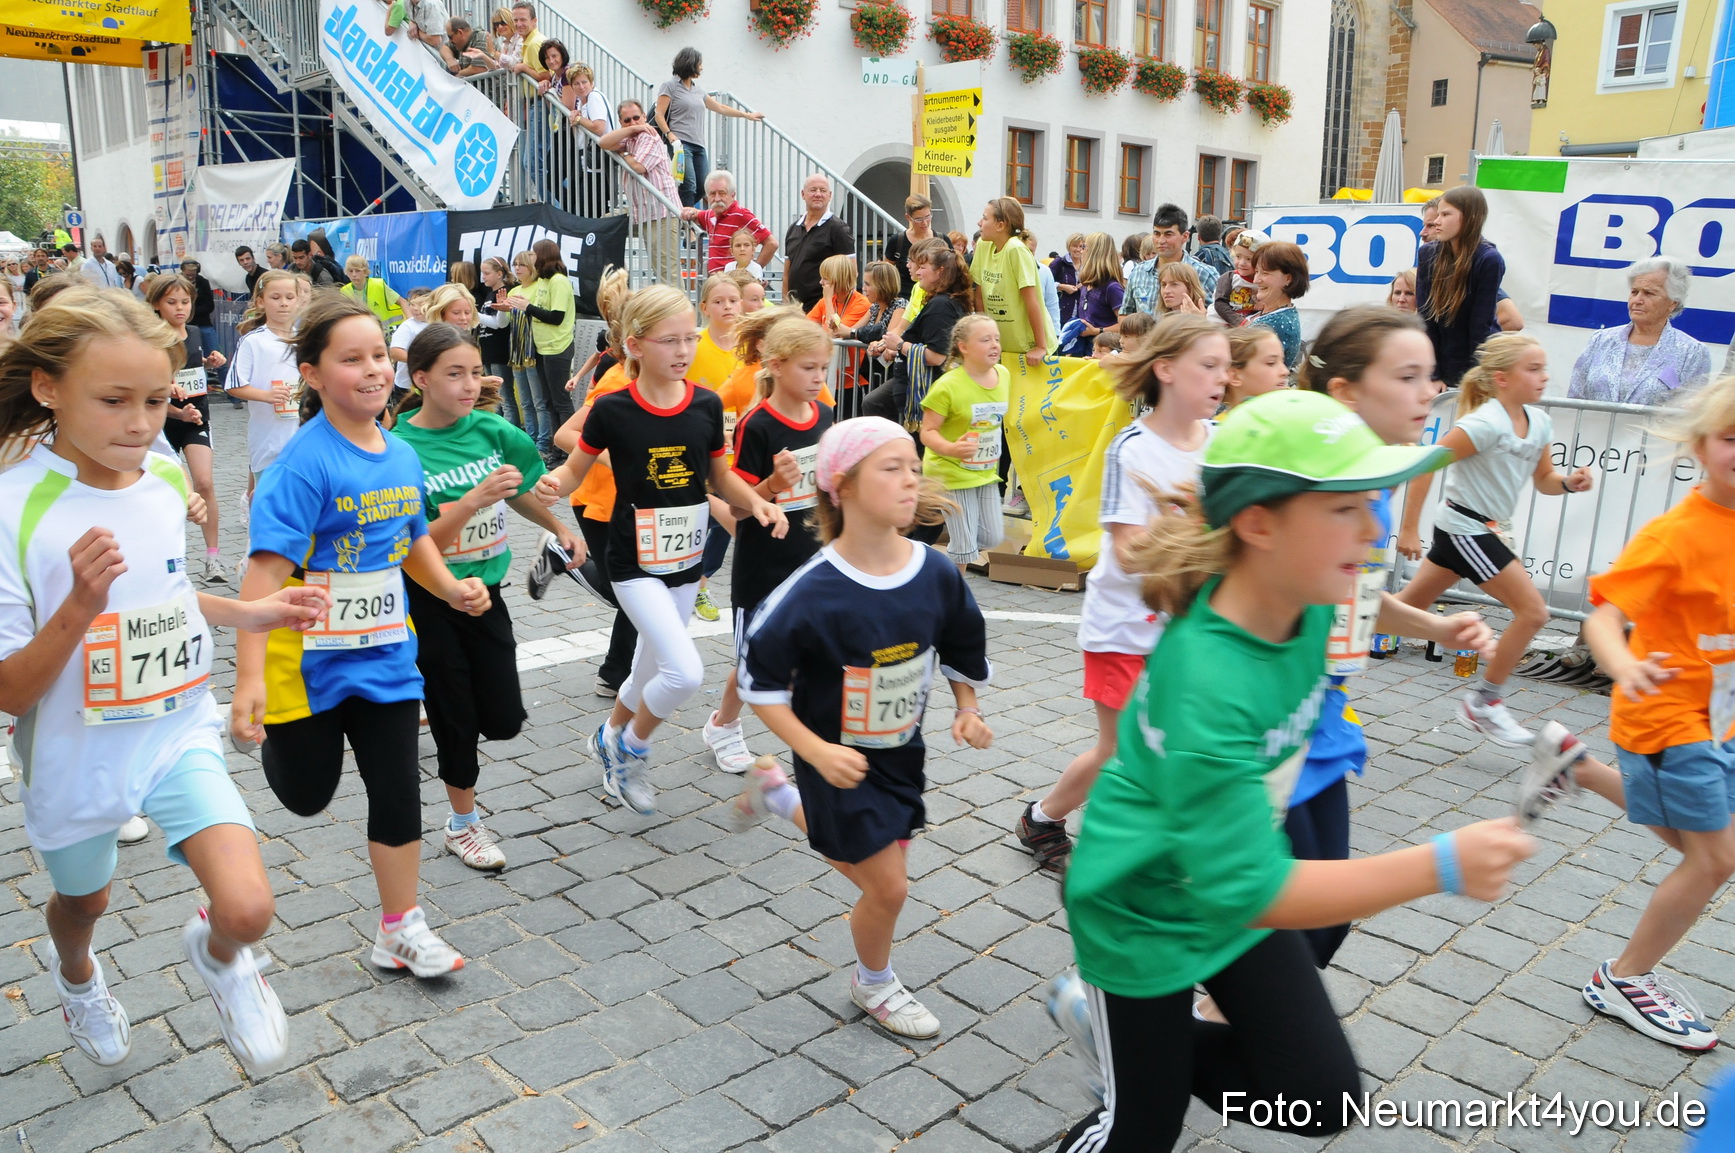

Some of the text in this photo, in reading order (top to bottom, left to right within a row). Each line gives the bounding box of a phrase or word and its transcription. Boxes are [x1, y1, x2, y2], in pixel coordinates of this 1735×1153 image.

[105, 3, 158, 18] Stadtlauf
[5, 26, 121, 45] Neumarkter Stadtlauf
[926, 114, 965, 126] Kleiderbeutel-
[933, 125, 958, 135] ausgabe
[924, 150, 957, 162] Kinder-
[917, 162, 963, 177] betreuung
[389, 254, 447, 274] maxi-dsl.de
[335, 496, 359, 512] 10.
[466, 512, 504, 543] 7056
[659, 513, 688, 527] Fanny
[641, 529, 702, 552] K5 7218
[337, 593, 395, 620] 7309
[128, 606, 187, 640] Michelle
[92, 658, 110, 674] K5
[132, 634, 202, 684] 7147
